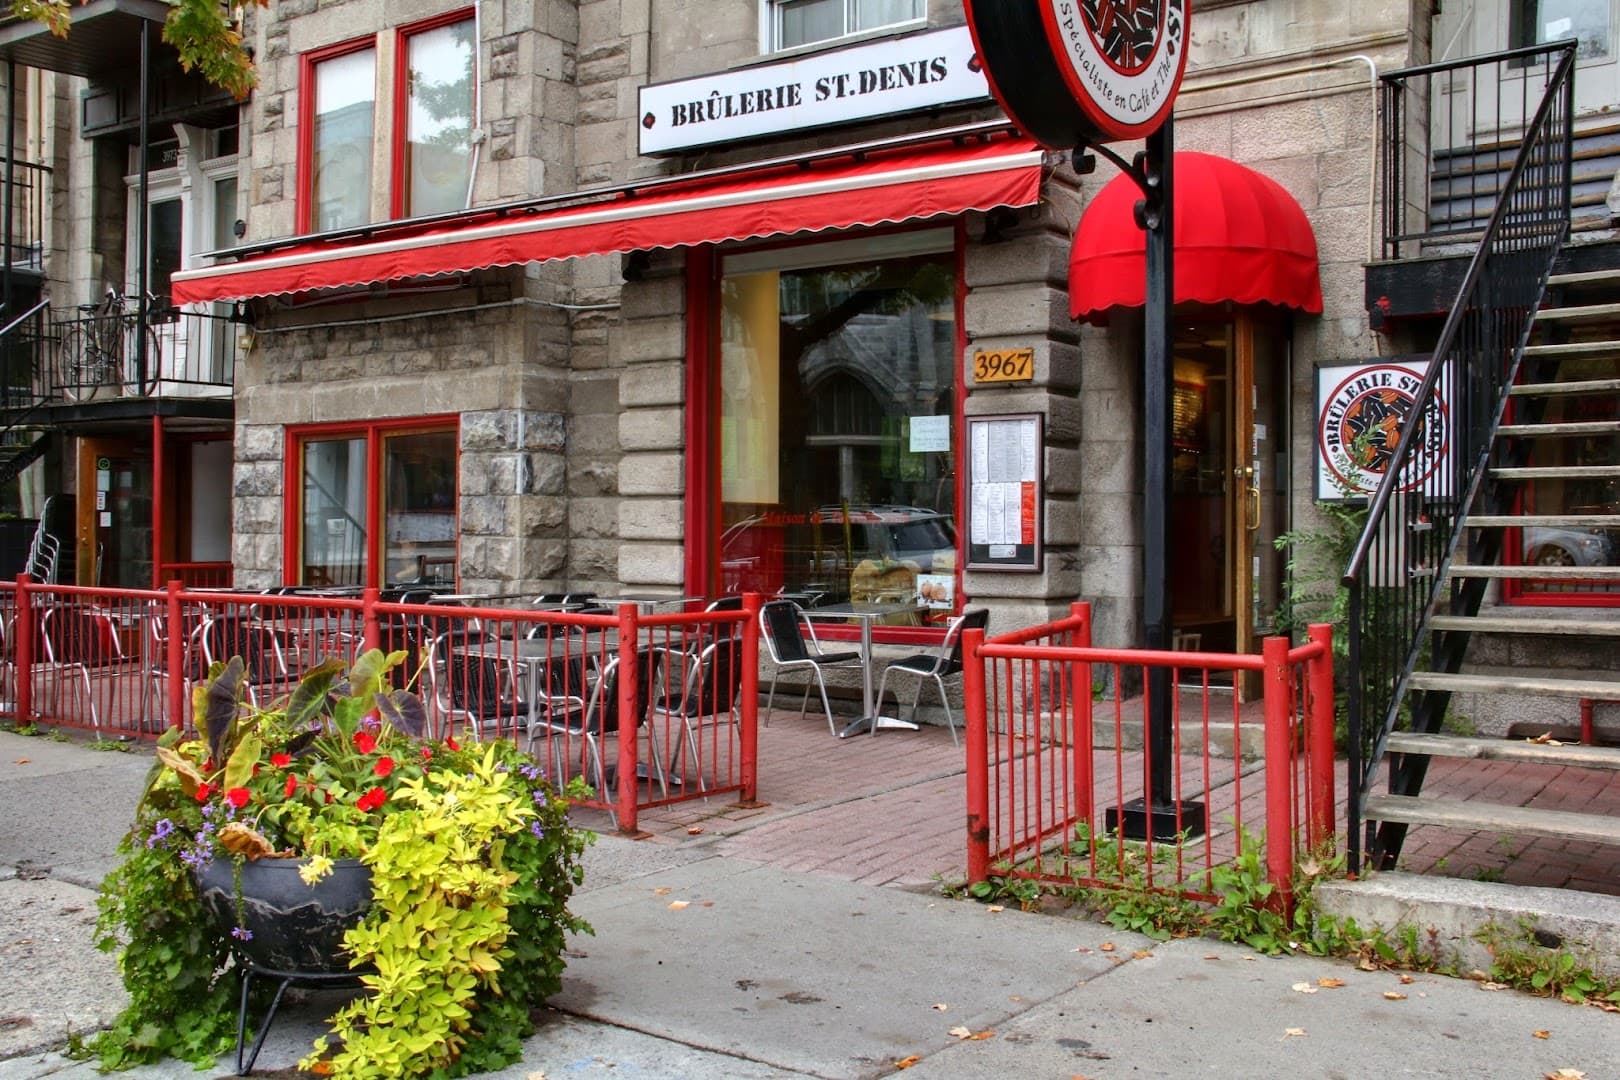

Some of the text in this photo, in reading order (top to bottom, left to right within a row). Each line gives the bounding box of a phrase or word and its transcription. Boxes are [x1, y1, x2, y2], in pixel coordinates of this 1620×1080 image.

[671, 83, 802, 127] BRÛLERIE
[1115, 94, 1126, 109] en
[1129, 87, 1150, 113] Café
[1151, 80, 1162, 100] et
[976, 352, 1032, 380] 3967
[1326, 372, 1392, 446] BRÛLERIE
